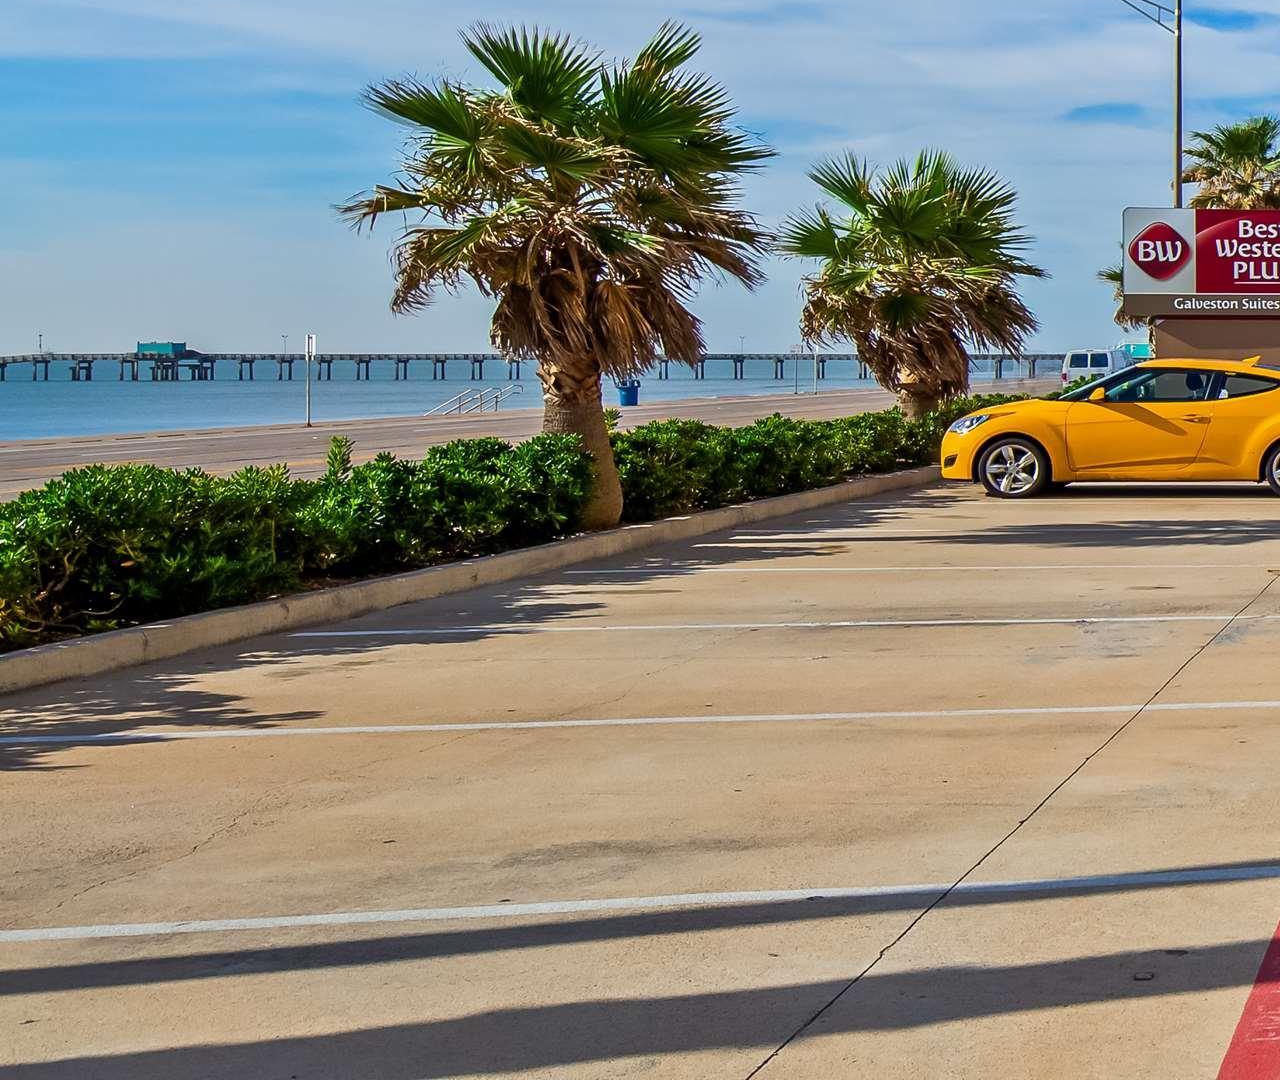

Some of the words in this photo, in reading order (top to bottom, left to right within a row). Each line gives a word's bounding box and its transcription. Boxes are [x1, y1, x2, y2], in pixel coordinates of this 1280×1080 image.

[1138, 240, 1182, 262] BW
[1174, 298, 1239, 310] Galveston
[1242, 298, 1280, 310] Suites
